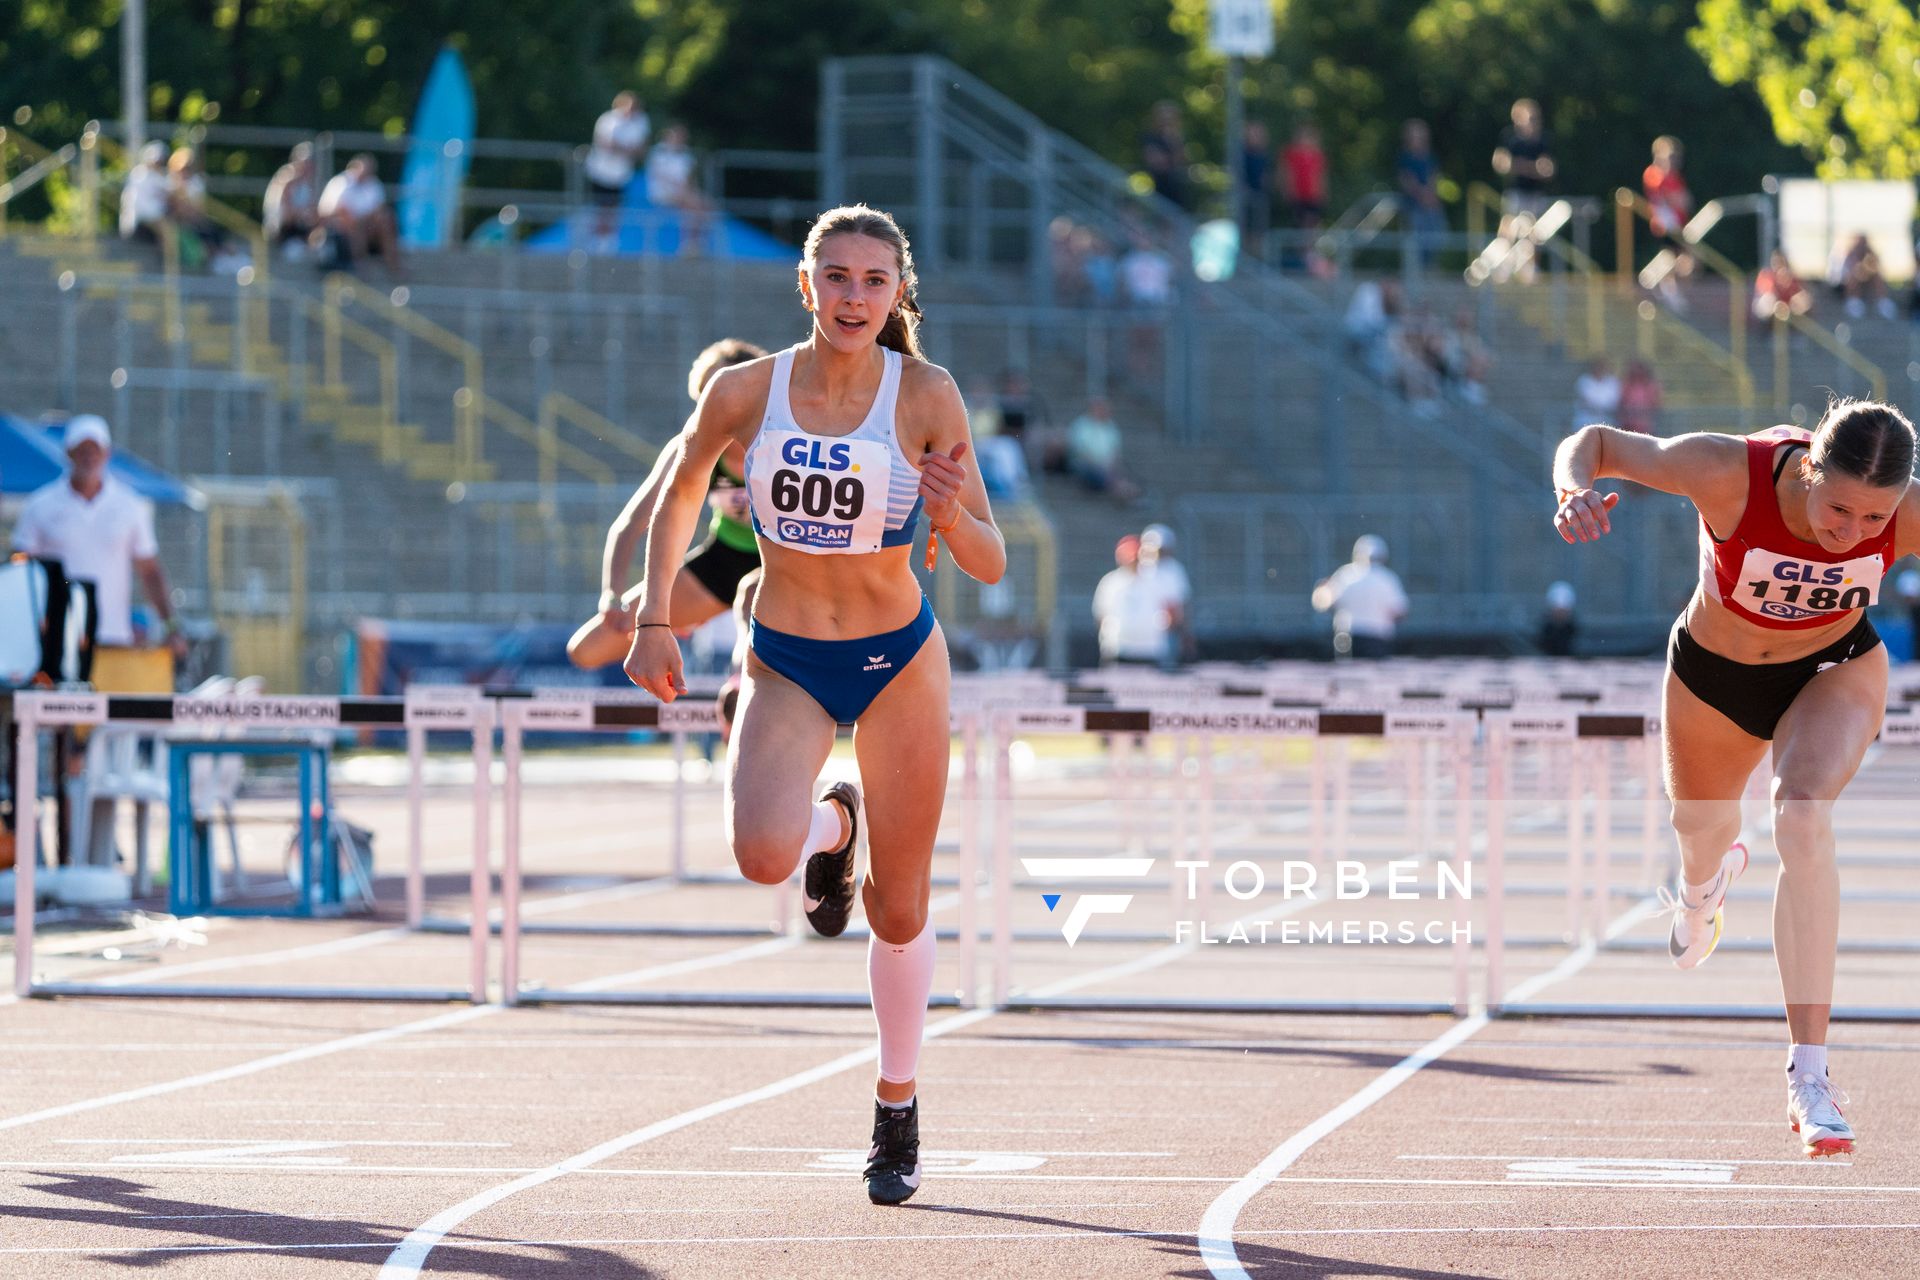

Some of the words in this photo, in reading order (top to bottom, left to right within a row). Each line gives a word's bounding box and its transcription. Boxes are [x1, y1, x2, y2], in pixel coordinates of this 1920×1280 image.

[771, 469, 864, 521] 609
[807, 525, 849, 539] PLAN
[807, 537, 848, 545] INTERNATIONAL
[1749, 581, 1870, 610] 1180
[863, 661, 892, 671] erima
[175, 699, 339, 720] DONAUSTADION
[1153, 713, 1318, 733] DONAUSTADION
